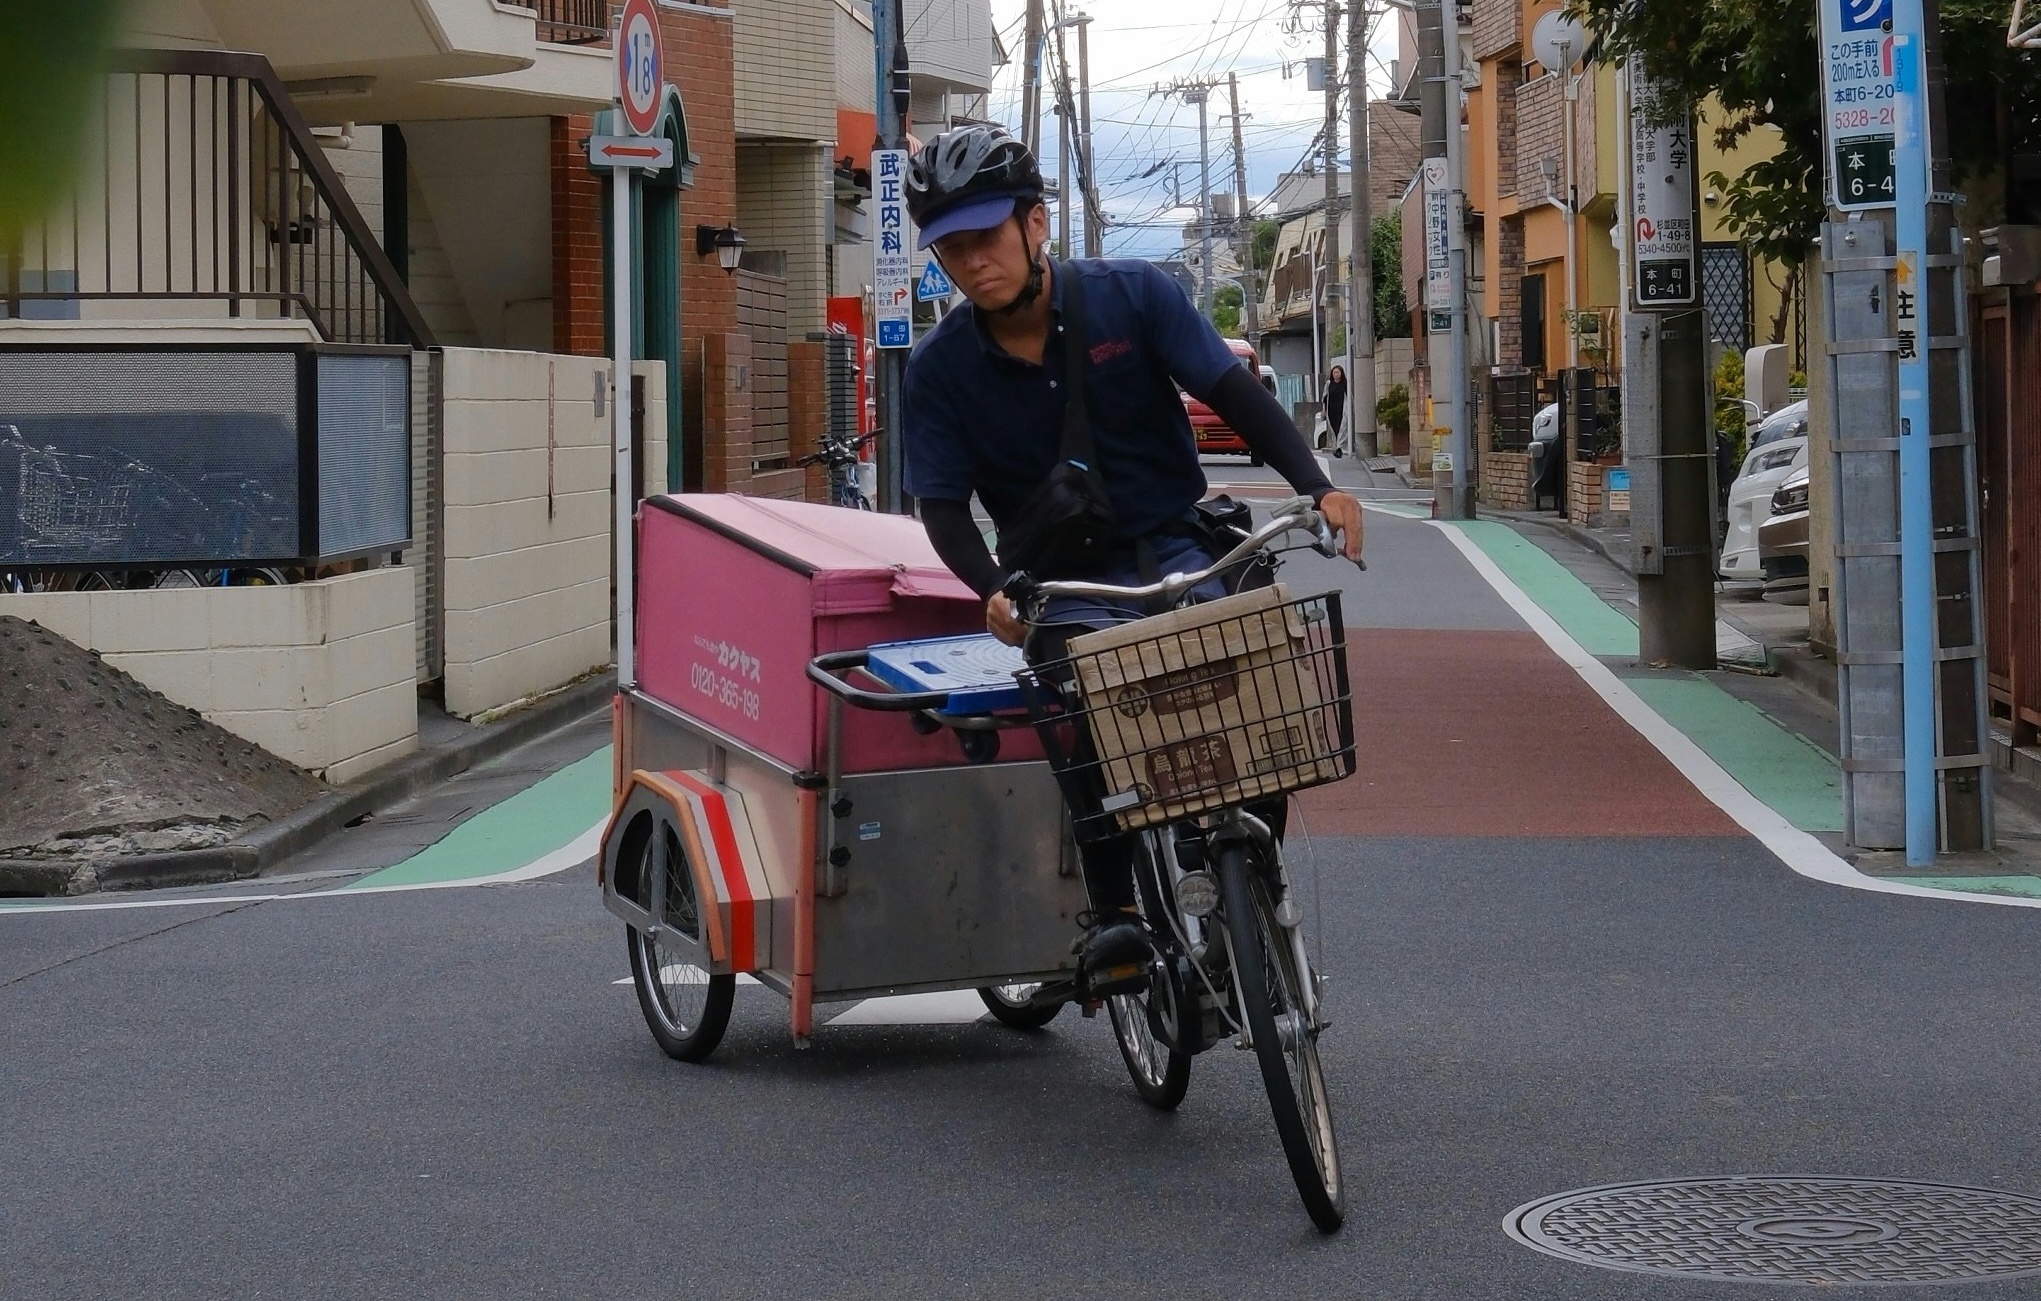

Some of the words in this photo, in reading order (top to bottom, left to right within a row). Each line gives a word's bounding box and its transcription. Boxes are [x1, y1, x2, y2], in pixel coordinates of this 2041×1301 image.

[1831, 40, 1878, 60] この手前
[1832, 60, 1879, 82] 200m左入る
[1834, 84, 1894, 104] 本町6-20
[880, 153, 902, 254] 武正内科
[1657, 219, 1690, 229] 杉並区和田
[1657, 230, 1691, 241] 1-49-8
[1646, 269, 1682, 280] 本町
[1648, 284, 1682, 295] 6-41
[718, 640, 760, 685] カクヤス
[691, 662, 759, 721] 0120-365-198
[1153, 739, 1221, 775] 烏龍茶
